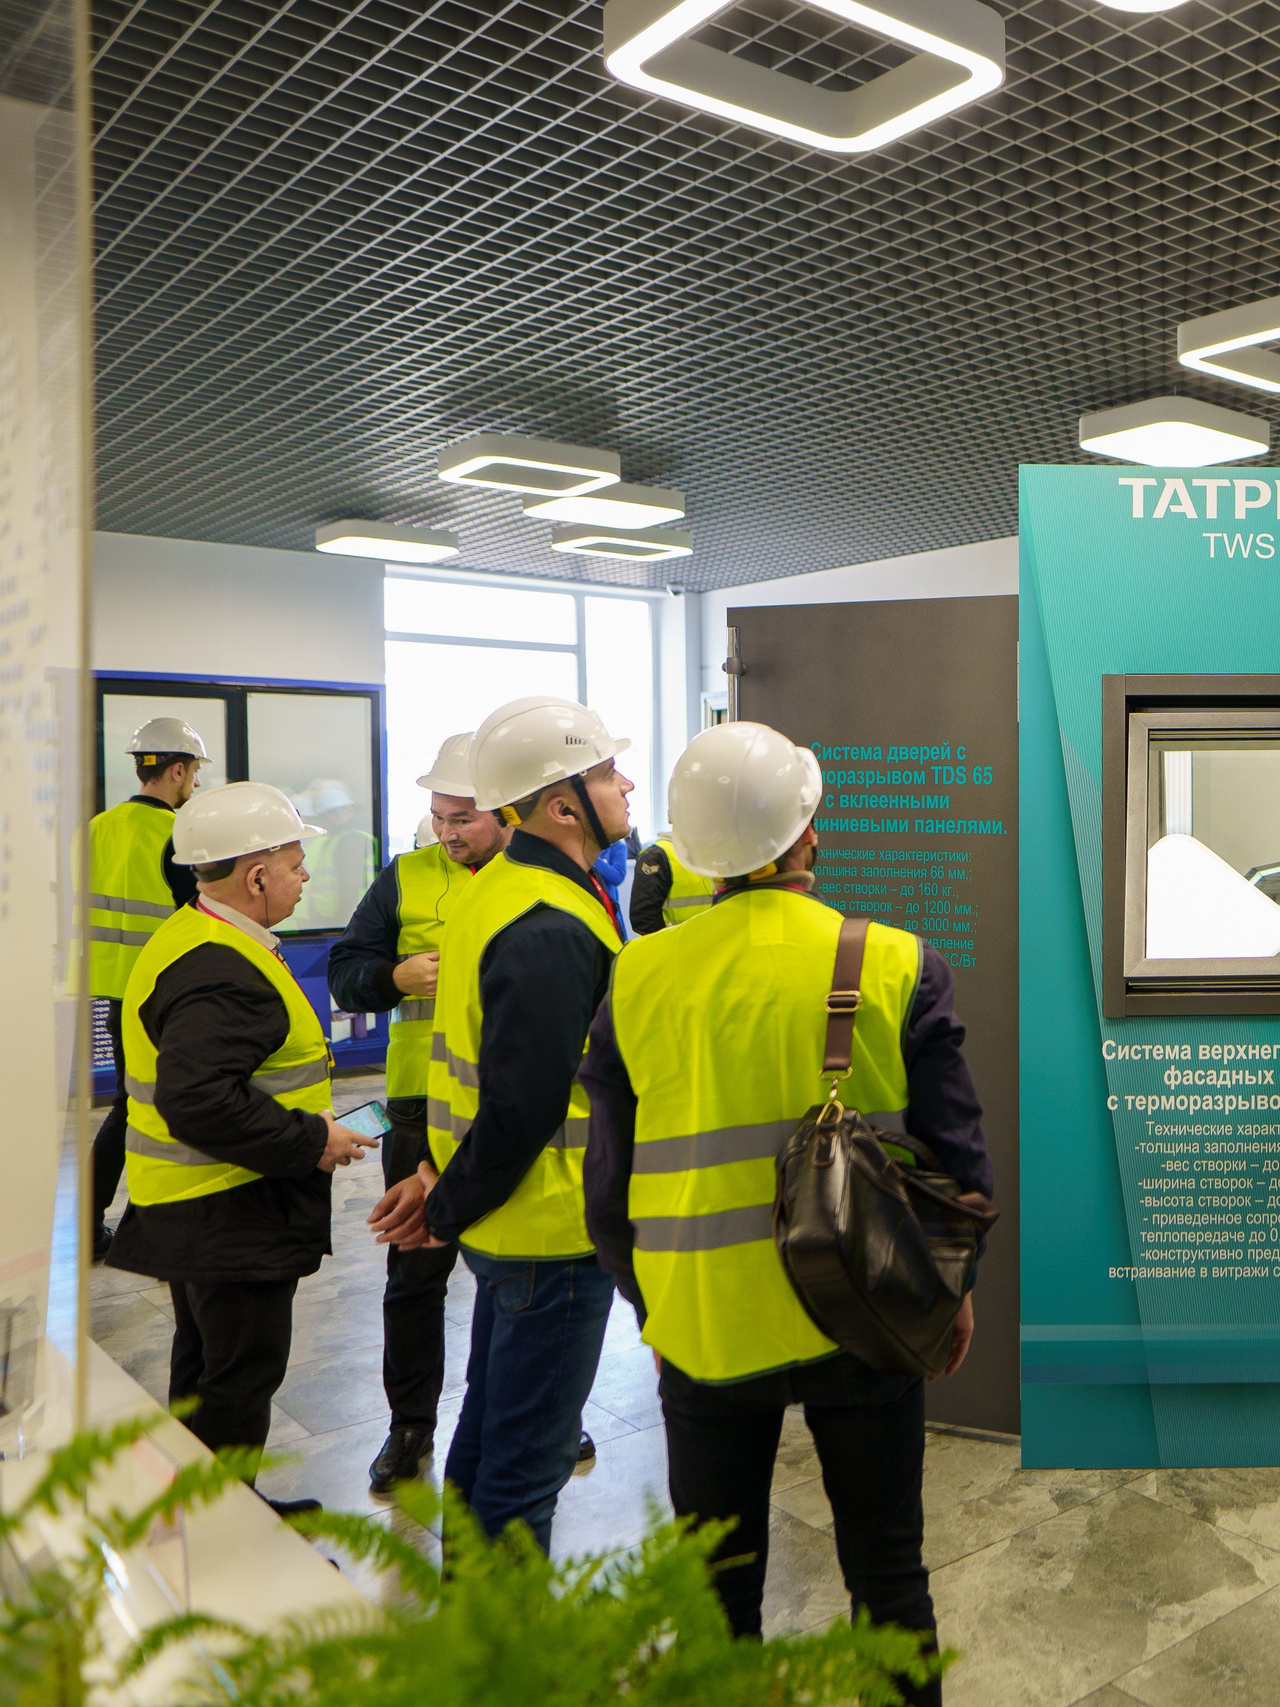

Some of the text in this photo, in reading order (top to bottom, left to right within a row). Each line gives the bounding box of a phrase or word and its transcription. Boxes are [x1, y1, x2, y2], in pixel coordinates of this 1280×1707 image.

[1202, 533, 1275, 558] TWS
[810, 742, 966, 764] Система дверей с
[821, 766, 993, 788] оразрывом TDS 65
[825, 794, 950, 809] с вклеенными
[815, 818, 1008, 835] иниевыми панелями.
[819, 849, 973, 864] хнические характеристики:
[813, 866, 973, 882] олщина заполнения 66 мм.;
[819, 882, 841, 893] -вес
[843, 883, 887, 897] створки
[900, 885, 915, 897] до
[919, 882, 938, 896] 160
[849, 901, 893, 914] створок
[905, 902, 920, 915] до
[924, 900, 951, 914] 1200
[955, 904, 979, 917] мм.;
[904, 920, 918, 932] до
[921, 917, 949, 932] 3000
[953, 922, 977, 935] мм.;
[944, 952, 977, 968] °С/Вт
[1102, 1040, 1191, 1060] Система
[1164, 1065, 1274, 1090] фасадных
[1107, 1095, 1118, 1110] с
[1146, 1121, 1232, 1135] Технические
[1135, 1142, 1199, 1156] -толщина
[1161, 1160, 1189, 1171] -вес
[1194, 1160, 1246, 1174] створки
[1263, 1160, 1279, 1173] до
[1138, 1178, 1195, 1192] -ширина
[1200, 1178, 1253, 1192] створок
[1140, 1196, 1193, 1207] -высота
[1198, 1196, 1251, 1210] створок
[1153, 1214, 1241, 1228] приведенное
[1140, 1231, 1245, 1245] теплопередаче
[1249, 1231, 1266, 1244] до
[1141, 1249, 1243, 1263] -конструктивно
[1109, 1267, 1195, 1280] встраивание
[1200, 1267, 1207, 1277] в
[1212, 1266, 1268, 1280] витражи
